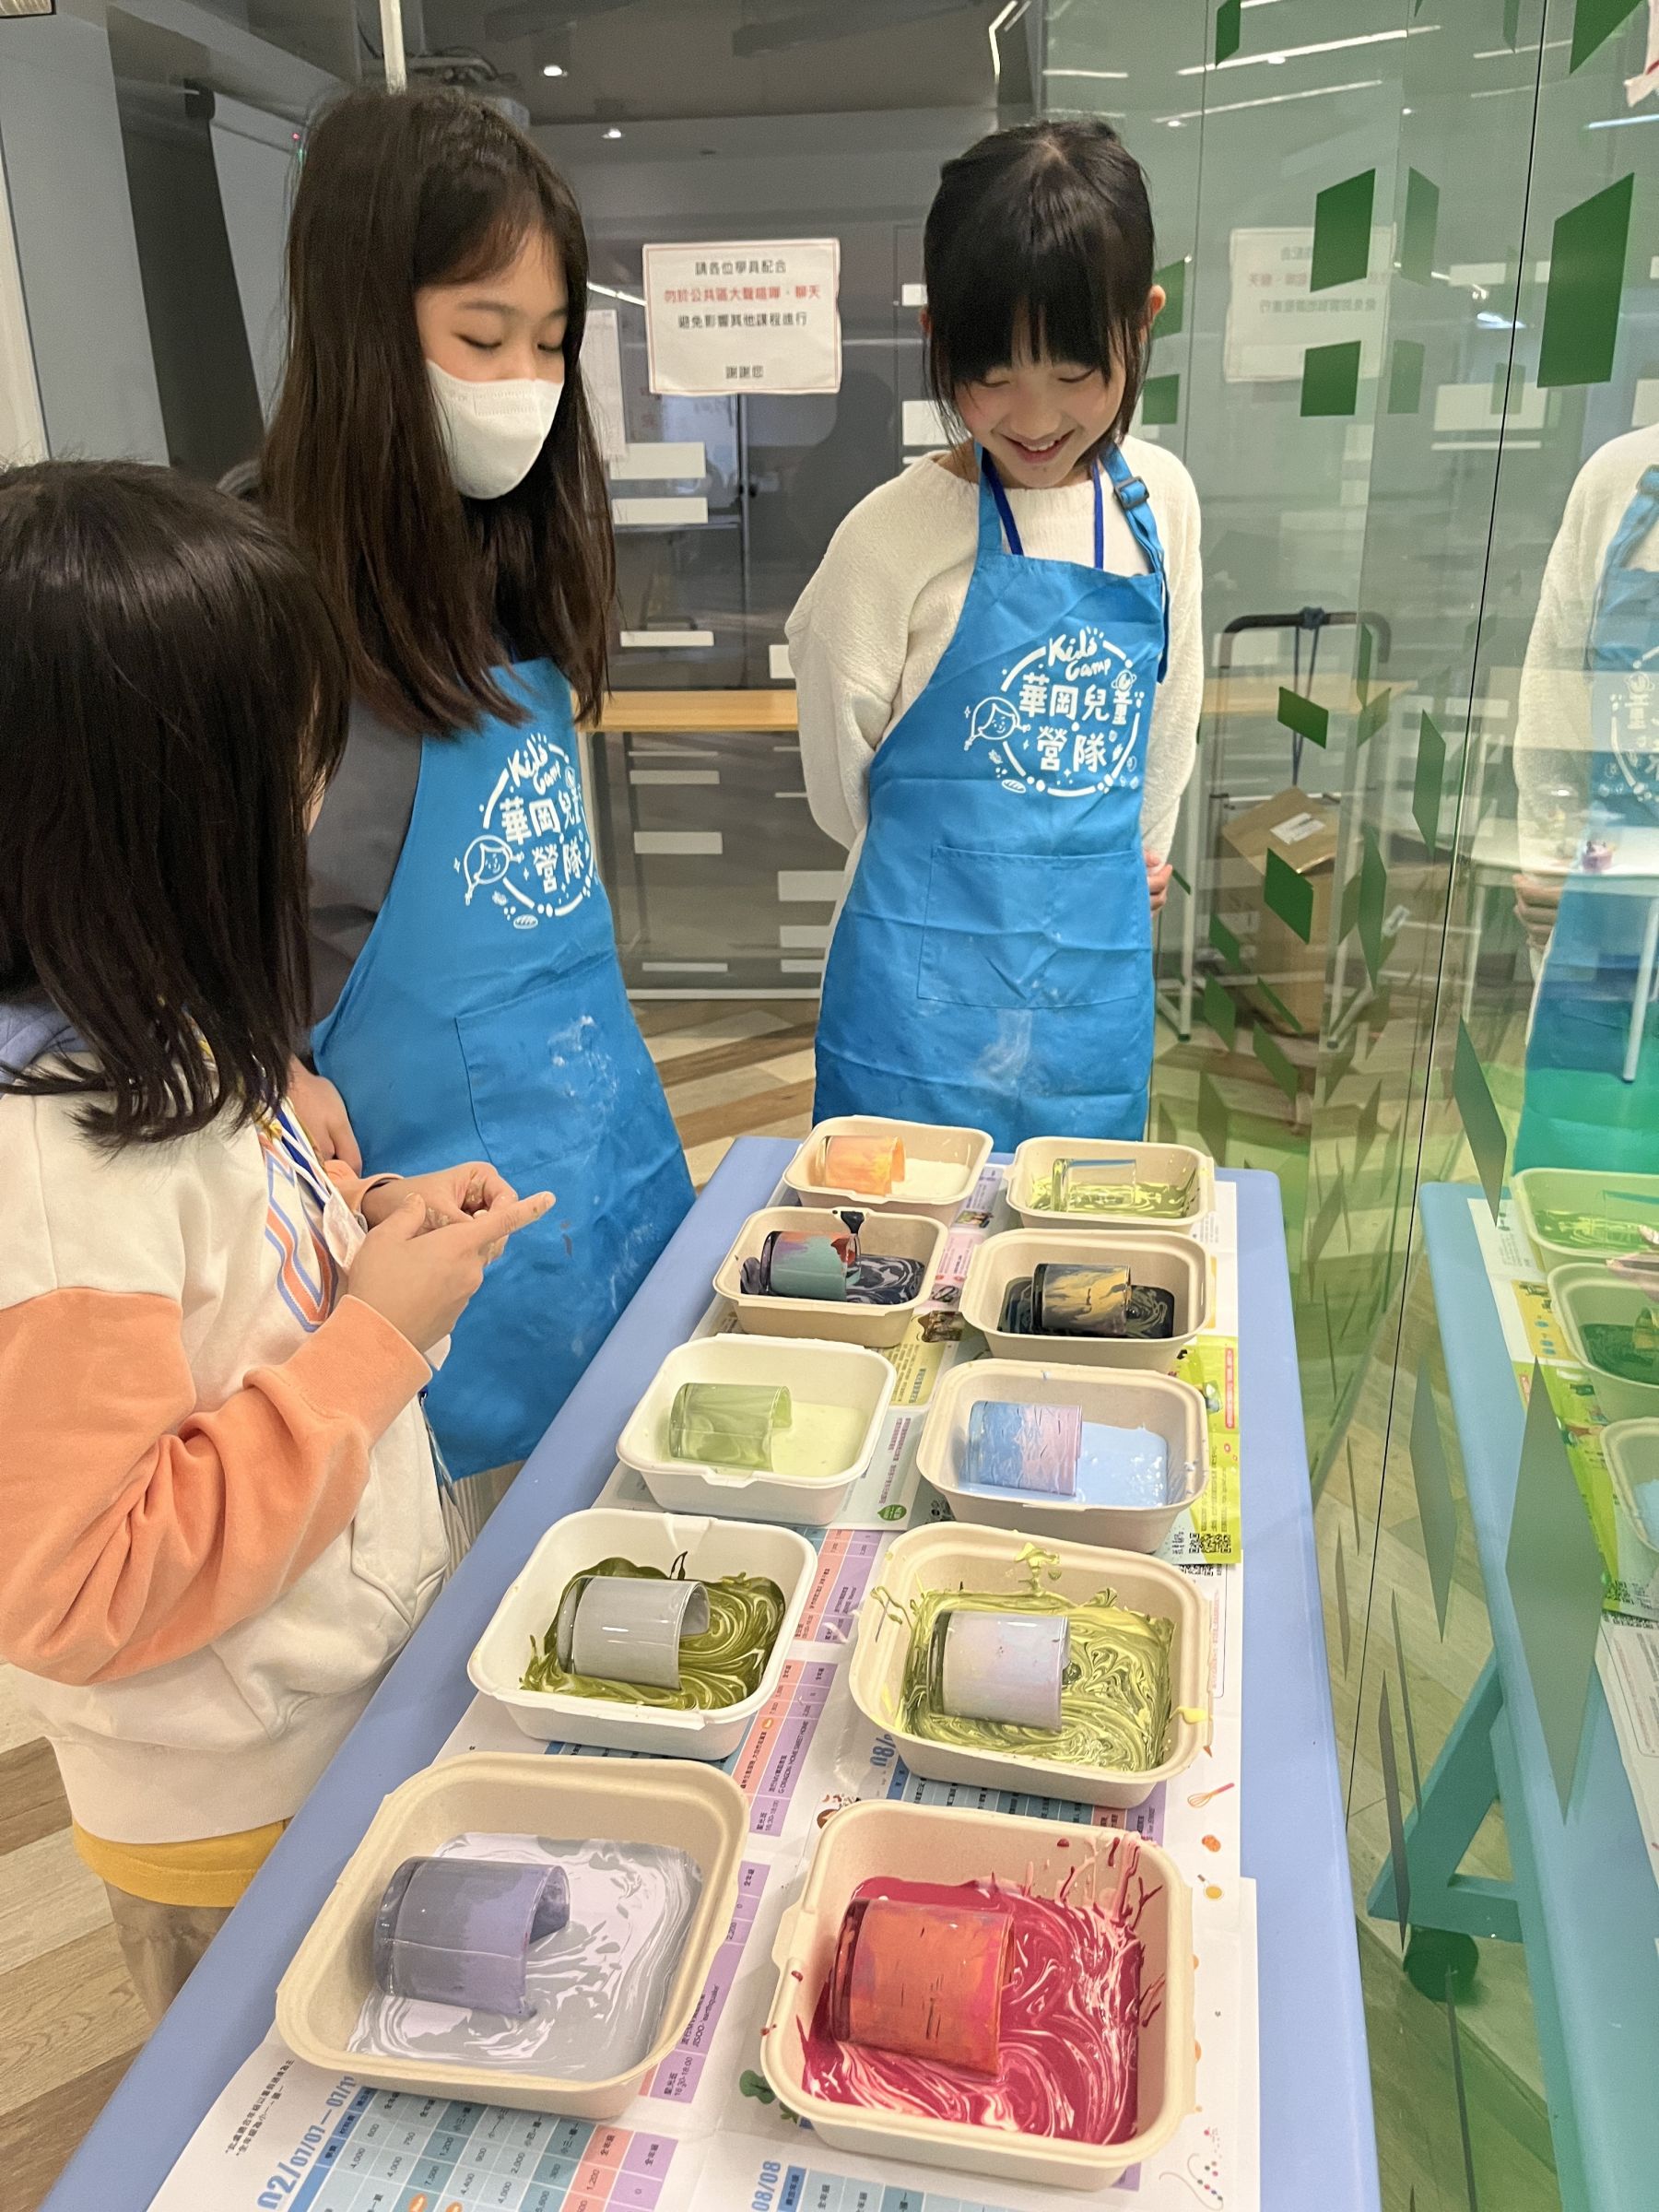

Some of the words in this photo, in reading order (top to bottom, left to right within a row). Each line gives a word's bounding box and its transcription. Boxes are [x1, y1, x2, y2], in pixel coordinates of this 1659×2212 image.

[695, 259, 786, 276] 請各位學員配合
[677, 312, 807, 328] 避免影響其他課程進行
[1065, 658, 1112, 681] Camp
[1018, 672, 1133, 725] 華岡兒童
[1037, 725, 1107, 772] 營隊
[532, 835, 584, 894] 營隊
